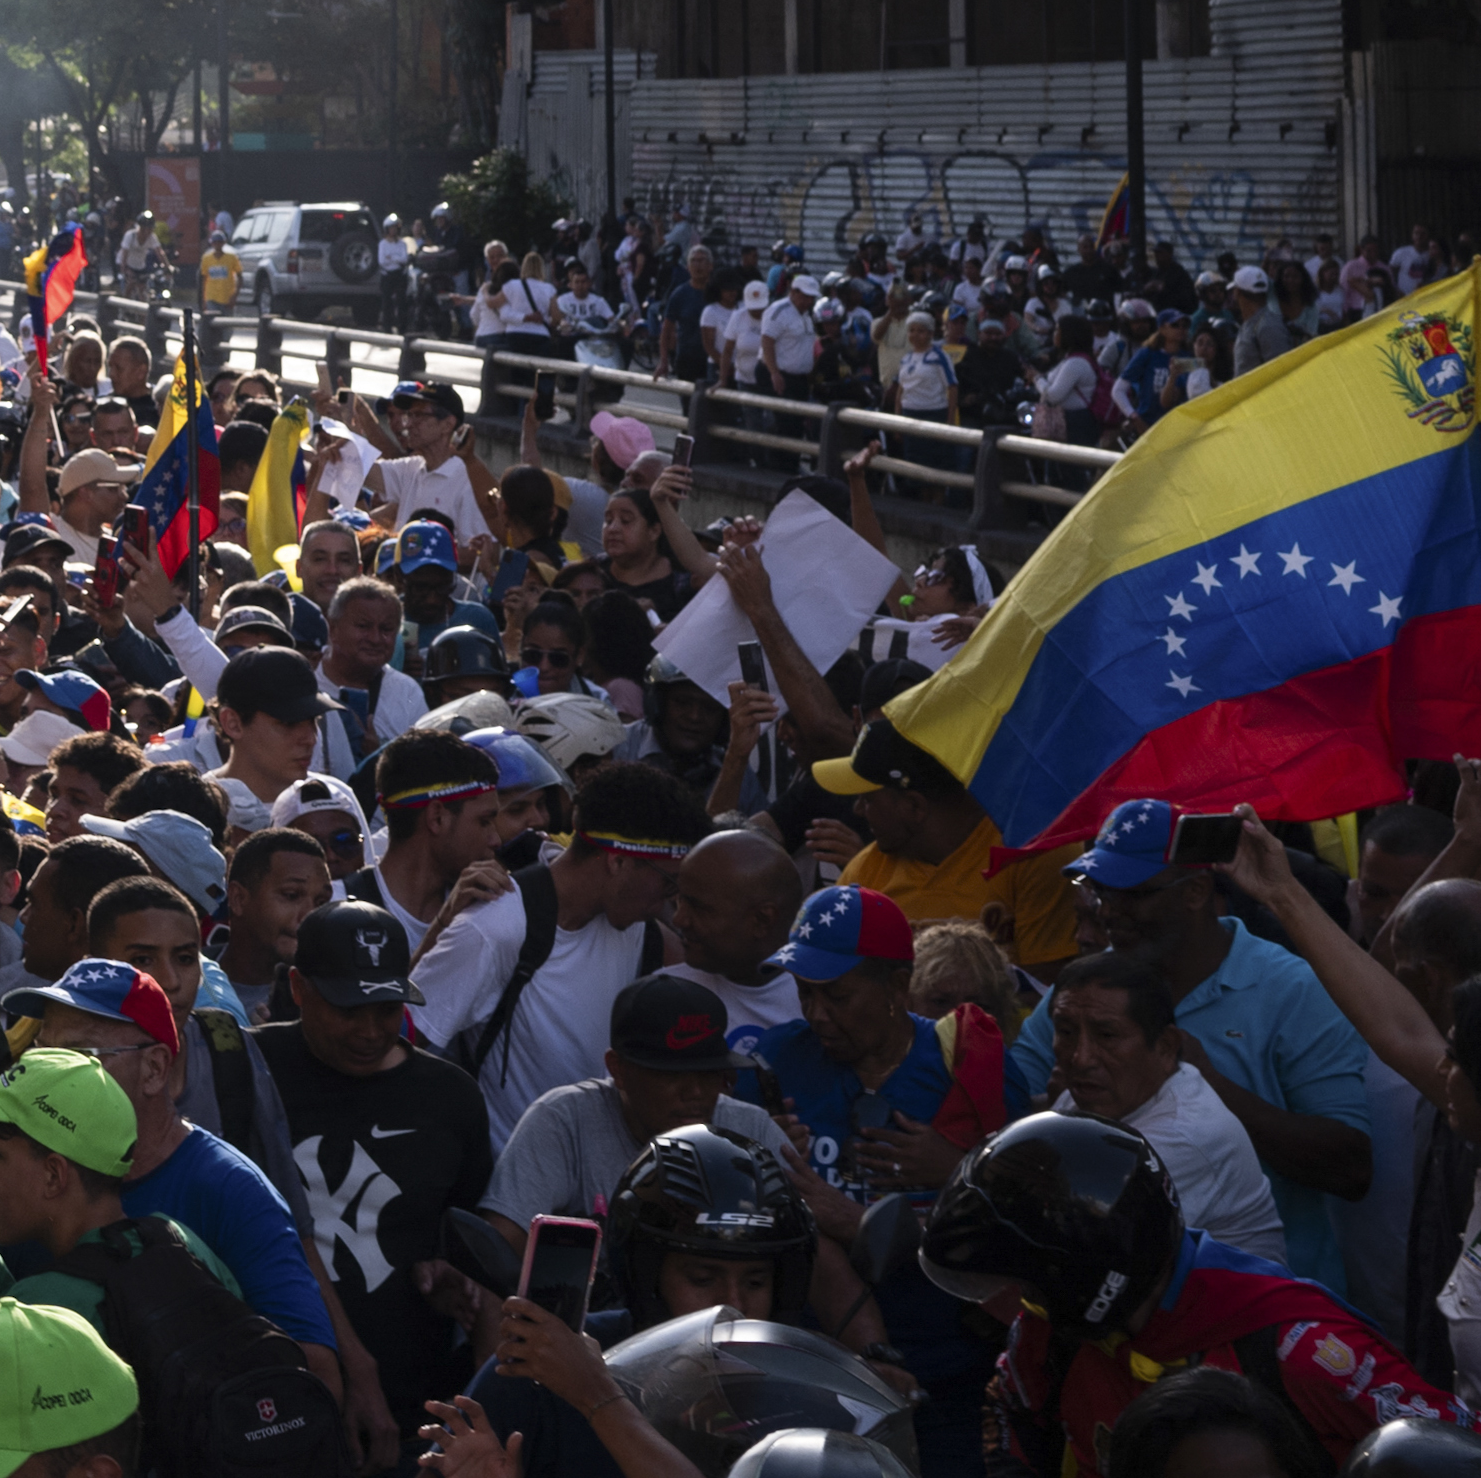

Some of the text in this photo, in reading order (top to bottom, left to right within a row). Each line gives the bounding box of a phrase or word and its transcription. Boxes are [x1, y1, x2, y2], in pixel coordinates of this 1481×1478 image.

[613, 840, 670, 853] Presidente
[695, 1211, 775, 1228] LS2
[1084, 1269, 1129, 1323] EDGE
[245, 1416, 306, 1442] VICTORINOX
